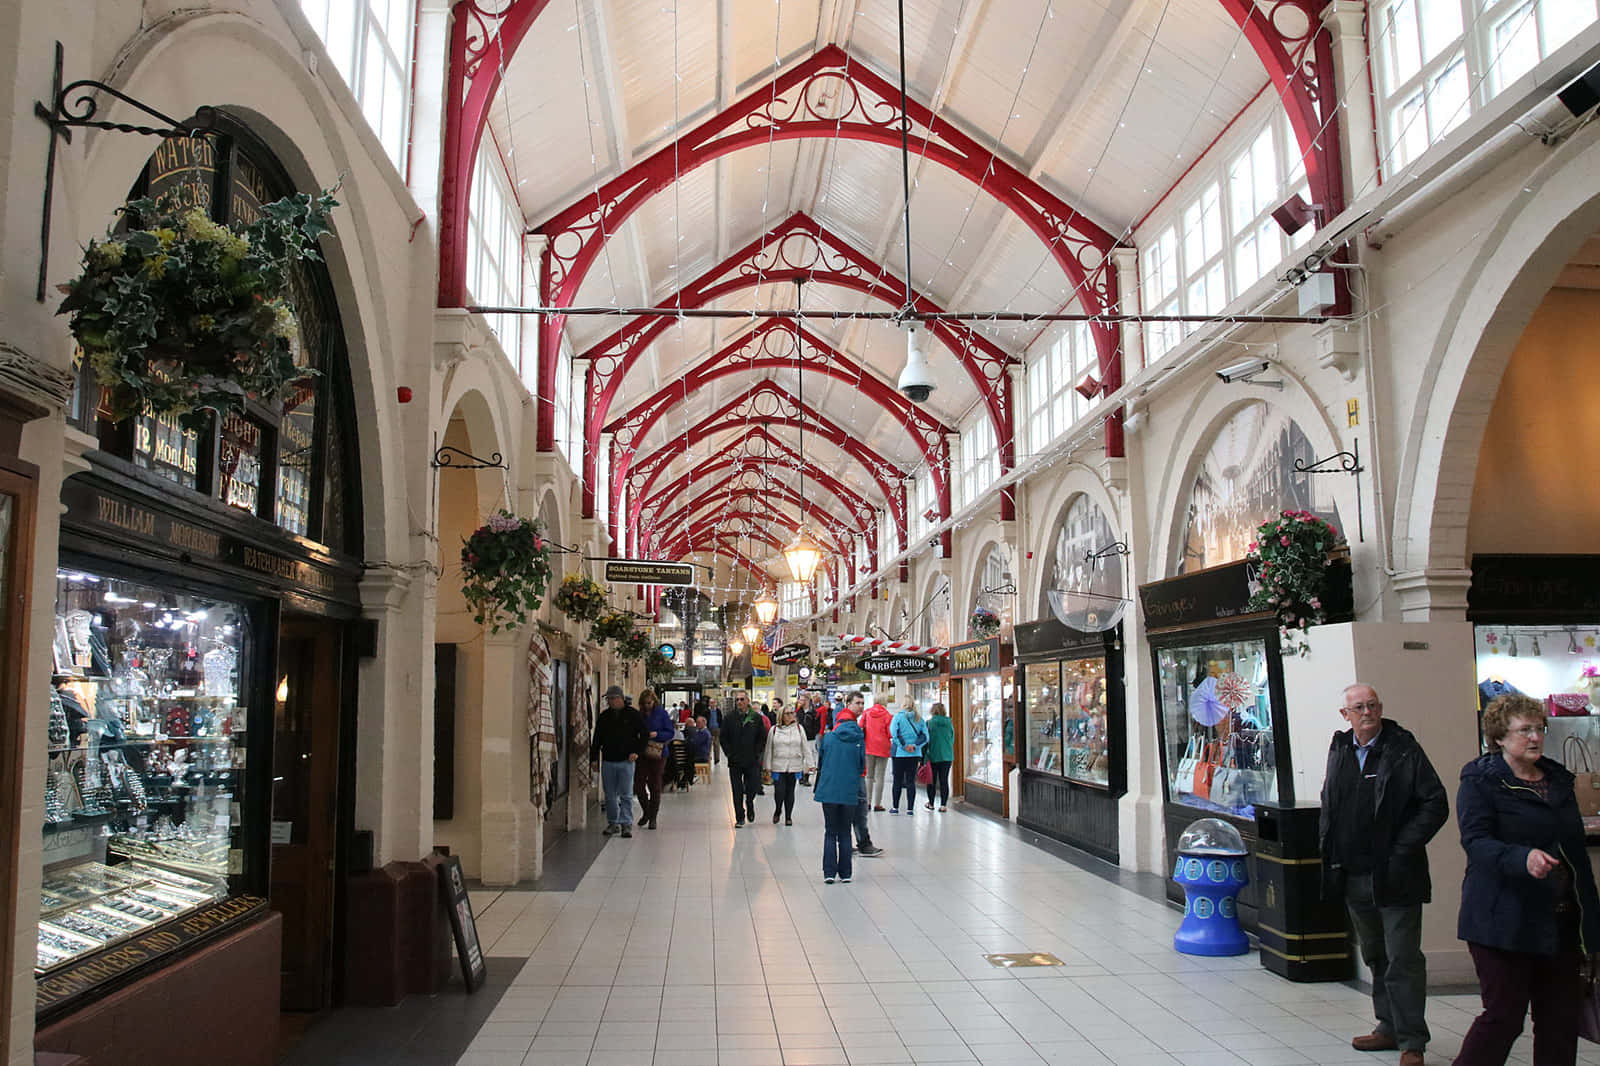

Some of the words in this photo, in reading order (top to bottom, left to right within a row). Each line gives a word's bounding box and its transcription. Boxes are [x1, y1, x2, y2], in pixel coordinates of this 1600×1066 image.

[152, 437, 197, 476] Months
[97, 495, 155, 537] WILLIAM
[168, 521, 221, 556] MORRISON
[656, 567, 690, 576] TARTANS
[864, 659, 902, 672] BARBER
[902, 657, 927, 669] SHOP
[36, 945, 149, 1007] TCHMAKERS
[138, 931, 181, 953] AND
[180, 893, 264, 936] JEWELLERS
